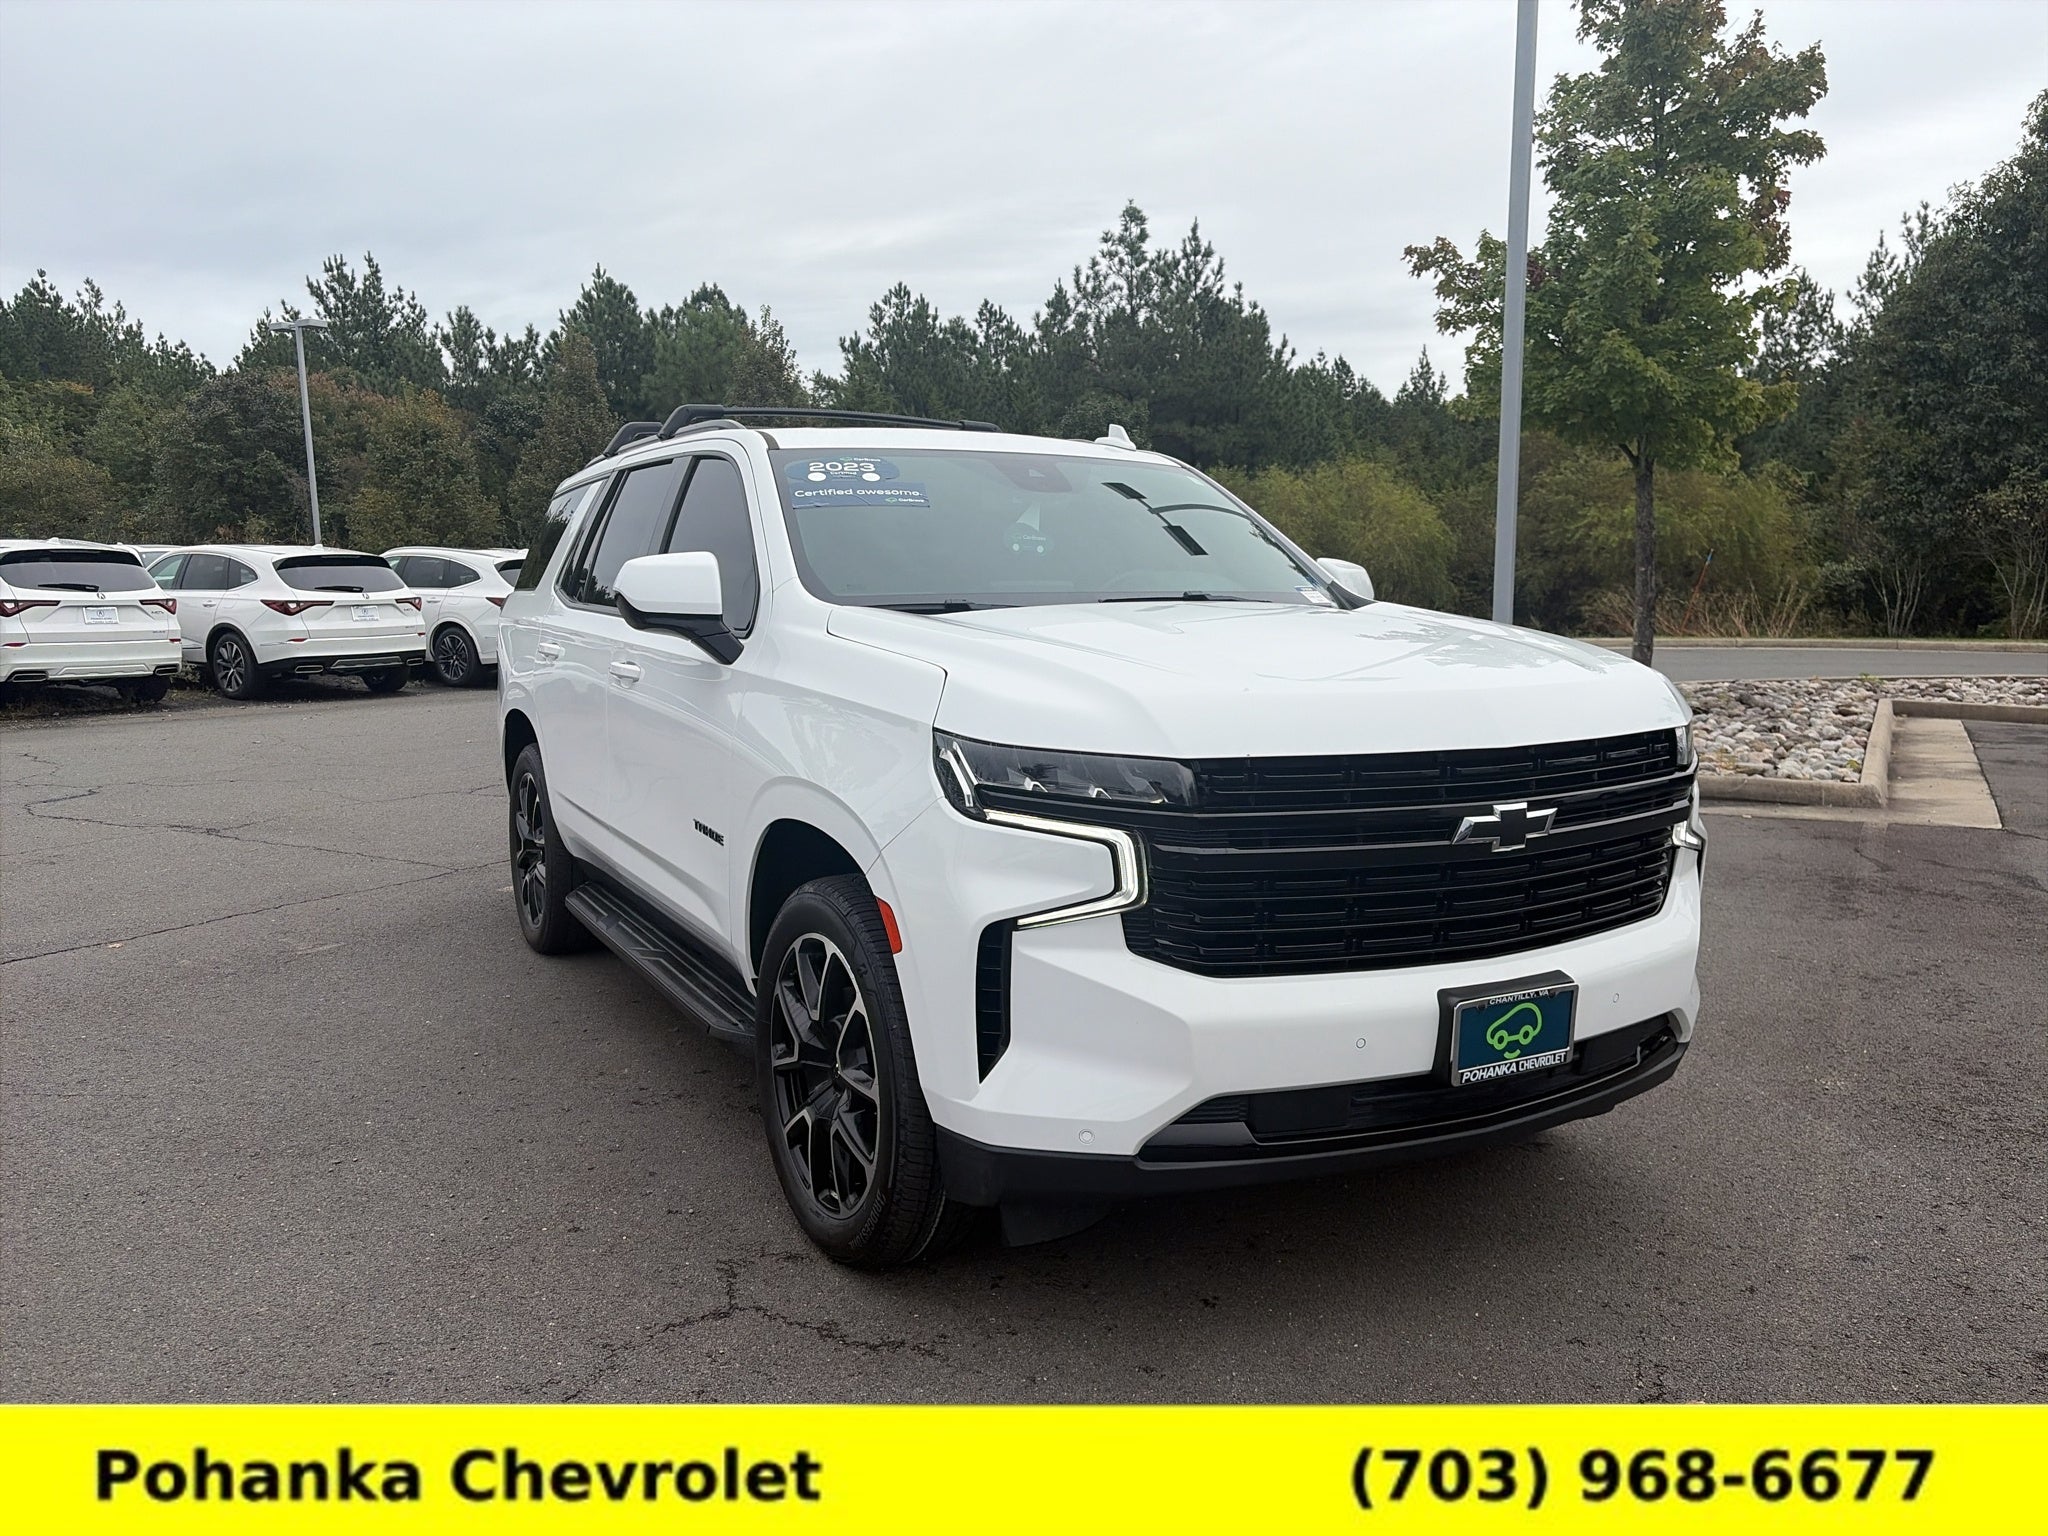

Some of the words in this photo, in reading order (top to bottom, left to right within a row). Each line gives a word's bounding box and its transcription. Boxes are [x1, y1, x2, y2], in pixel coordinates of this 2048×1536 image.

[809, 462, 876, 472] 2023
[794, 488, 853, 498] Certified
[856, 488, 923, 497] awesome.
[693, 818, 725, 847] TAHOE
[1462, 1061, 1517, 1084] POHANKA
[1518, 1051, 1567, 1071] CHEVROLET
[847, 1187, 888, 1250] BRIDGESTON
